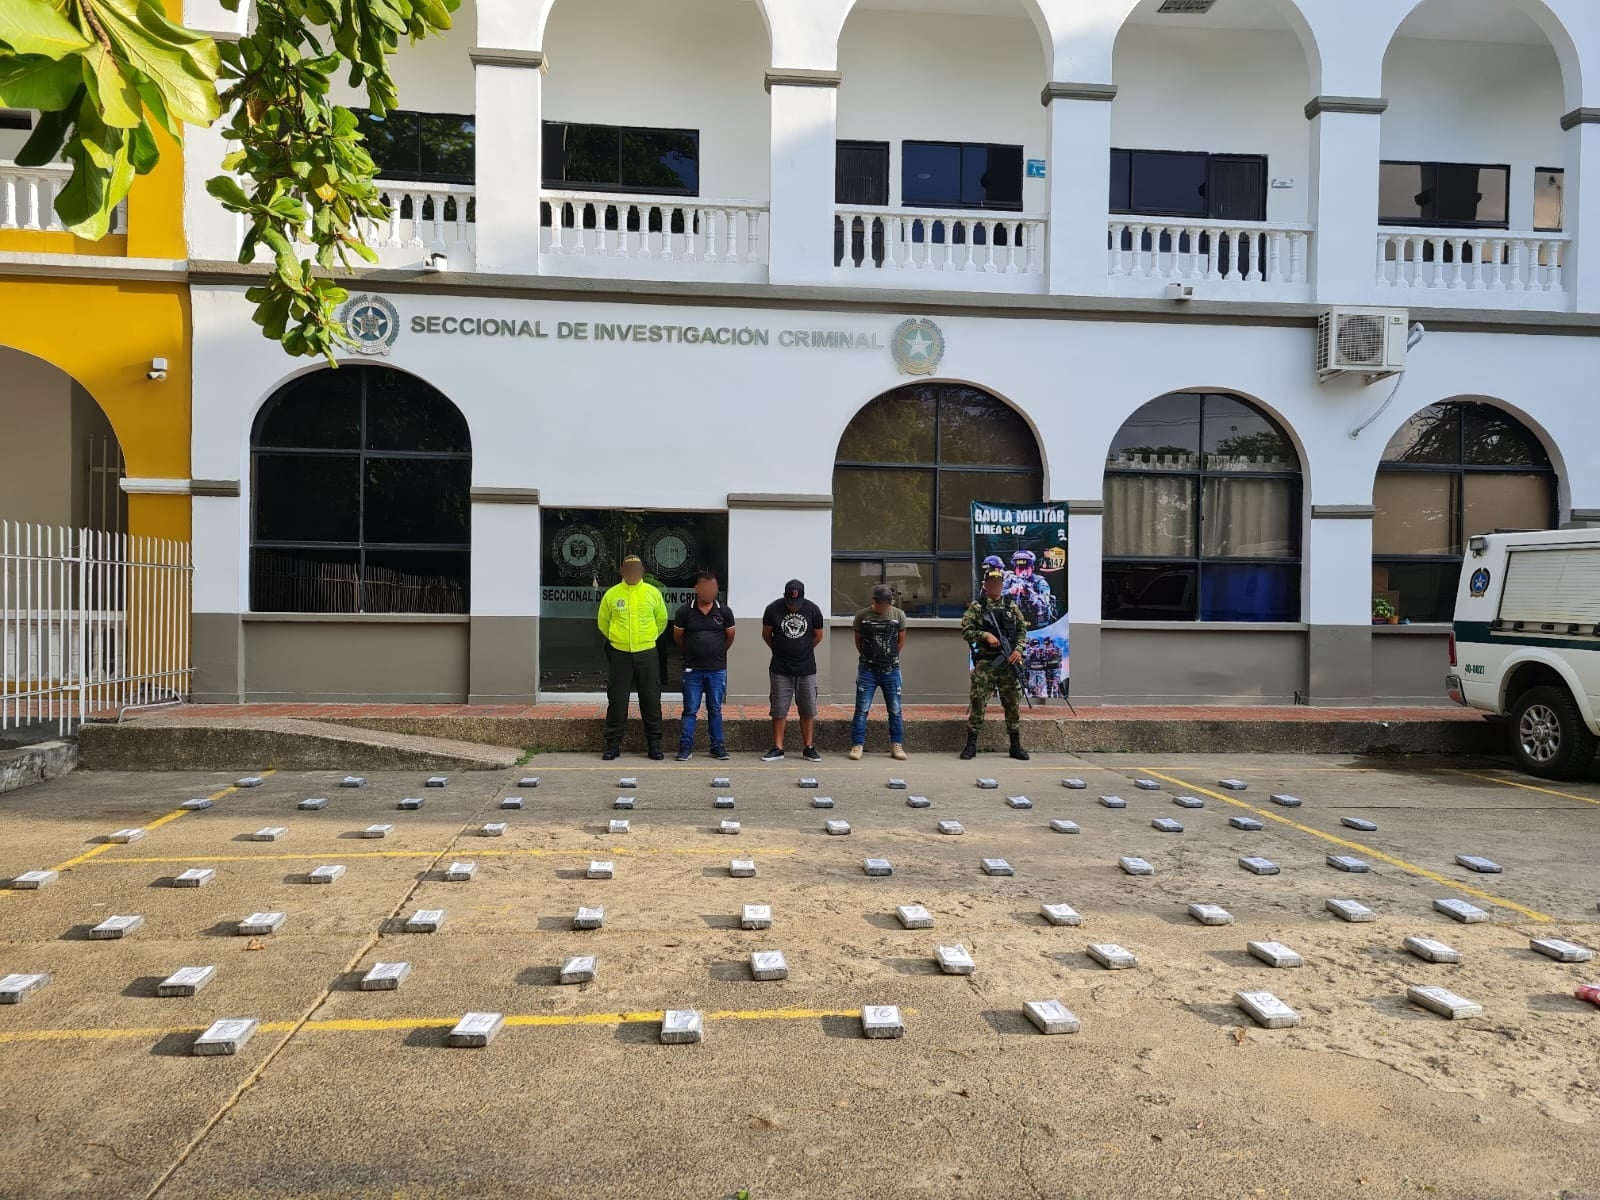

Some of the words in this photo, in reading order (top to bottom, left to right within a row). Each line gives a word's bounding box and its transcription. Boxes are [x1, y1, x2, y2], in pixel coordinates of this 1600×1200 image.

[410, 315, 549, 338] SECCIONAL
[557, 321, 588, 340] DE
[594, 322, 769, 346] INVESTIGACIÓN
[778, 329, 885, 350] CRIMINAL
[974, 508, 1013, 523] GAULA
[1016, 509, 1065, 523] MILITAR
[1010, 525, 1027, 535] 147
[542, 589, 594, 602] SECCIONAL
